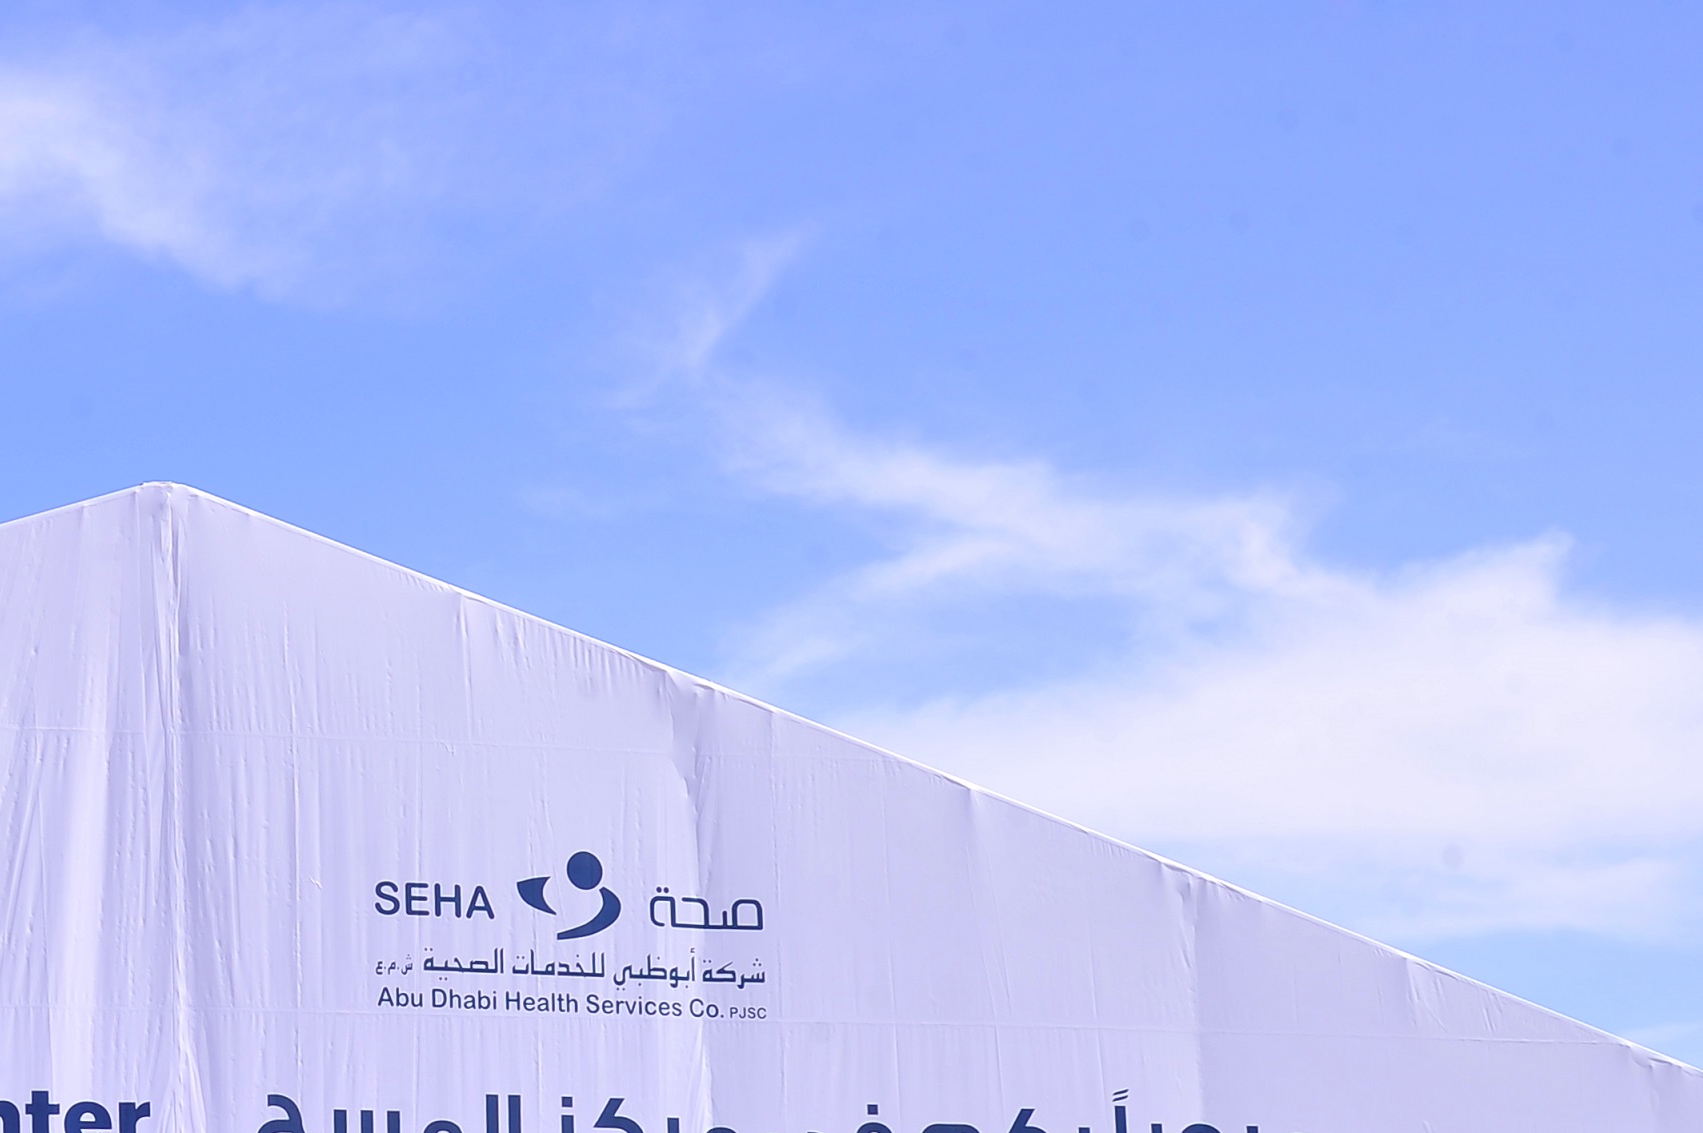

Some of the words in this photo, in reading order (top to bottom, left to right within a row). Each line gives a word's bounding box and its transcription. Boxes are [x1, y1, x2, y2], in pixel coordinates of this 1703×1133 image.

[375, 881, 494, 919] SEHA
[650, 886, 764, 931] صحة
[423, 947, 503, 980] الصحية
[512, 949, 605, 978] للخدمات
[613, 947, 696, 991] أبوظبي
[702, 958, 766, 989] شركة
[378, 987, 423, 1008] Abu
[431, 988, 497, 1010] Dhabi
[505, 992, 578, 1013] Health
[586, 995, 682, 1017] Services
[689, 999, 724, 1018] Co.
[730, 1006, 767, 1019] PJSC
